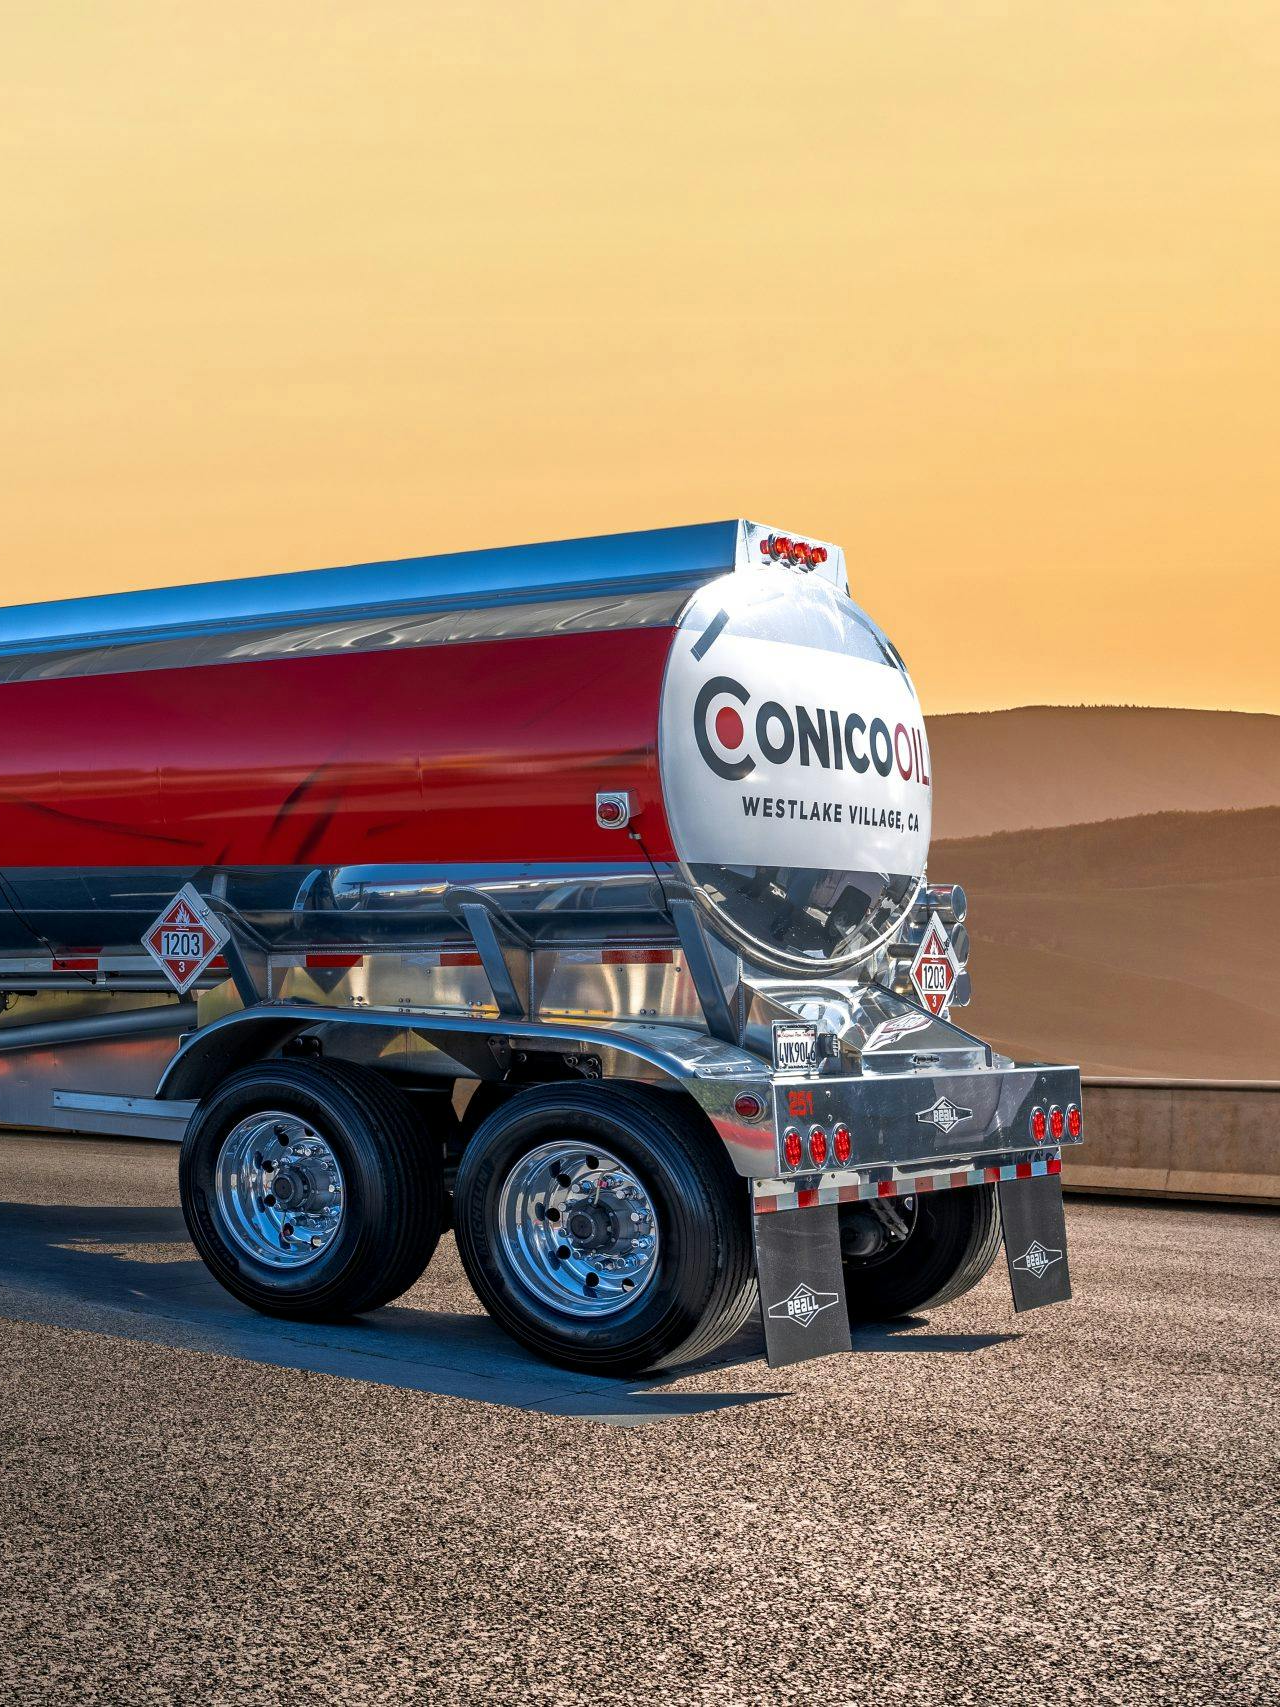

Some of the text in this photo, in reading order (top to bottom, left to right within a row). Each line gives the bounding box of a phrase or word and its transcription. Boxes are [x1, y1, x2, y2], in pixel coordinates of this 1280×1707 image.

[741, 796, 920, 833] WESTLAKE VILLAGE, CA
[163, 932, 201, 956] 1203
[178, 960, 187, 973] 3
[923, 964, 946, 989] 1203
[932, 995, 938, 1008] 3
